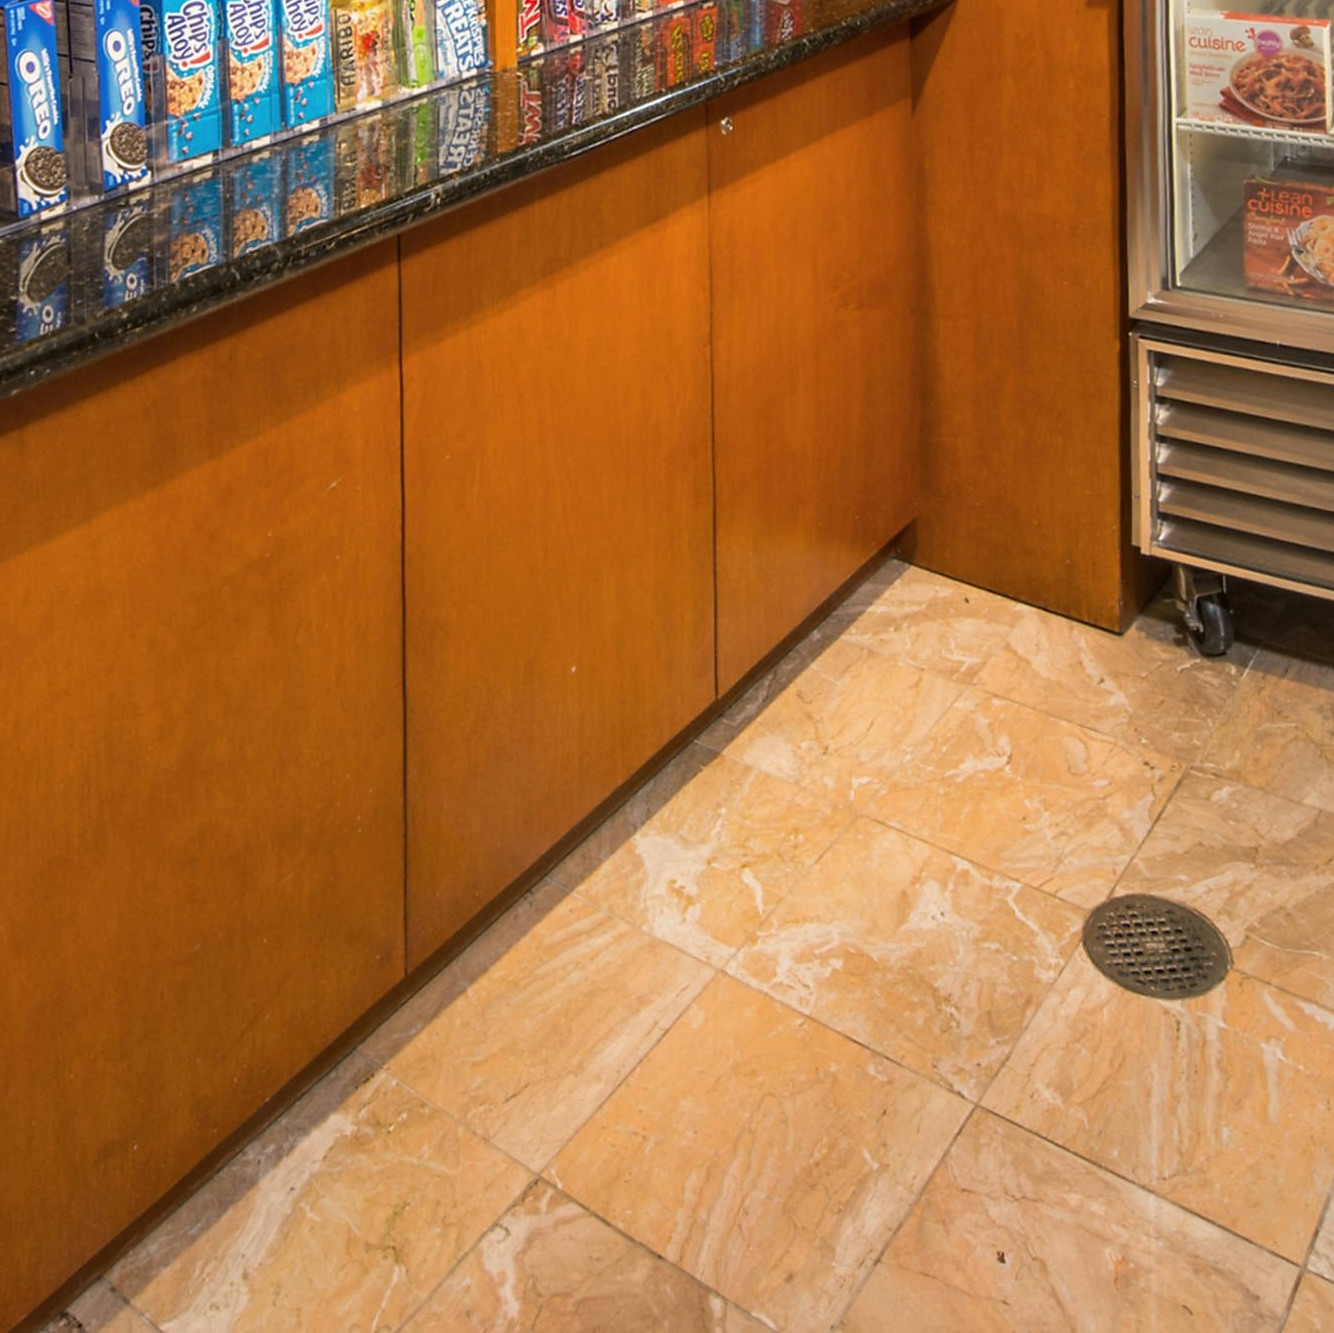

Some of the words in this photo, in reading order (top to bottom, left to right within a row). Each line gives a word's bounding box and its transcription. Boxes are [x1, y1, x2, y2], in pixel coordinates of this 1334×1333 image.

[182, 0, 208, 54] Chips
[337, 13, 357, 88] HARIBO
[465, 7, 485, 67] KRISPIES
[1188, 35, 1246, 53] cuisine
[17, 48, 51, 141] OREO
[105, 27, 136, 116] OREO
[1247, 198, 1313, 218] cuisine
[1270, 190, 1313, 206] Lean
[1247, 236, 1267, 246] Pasta
